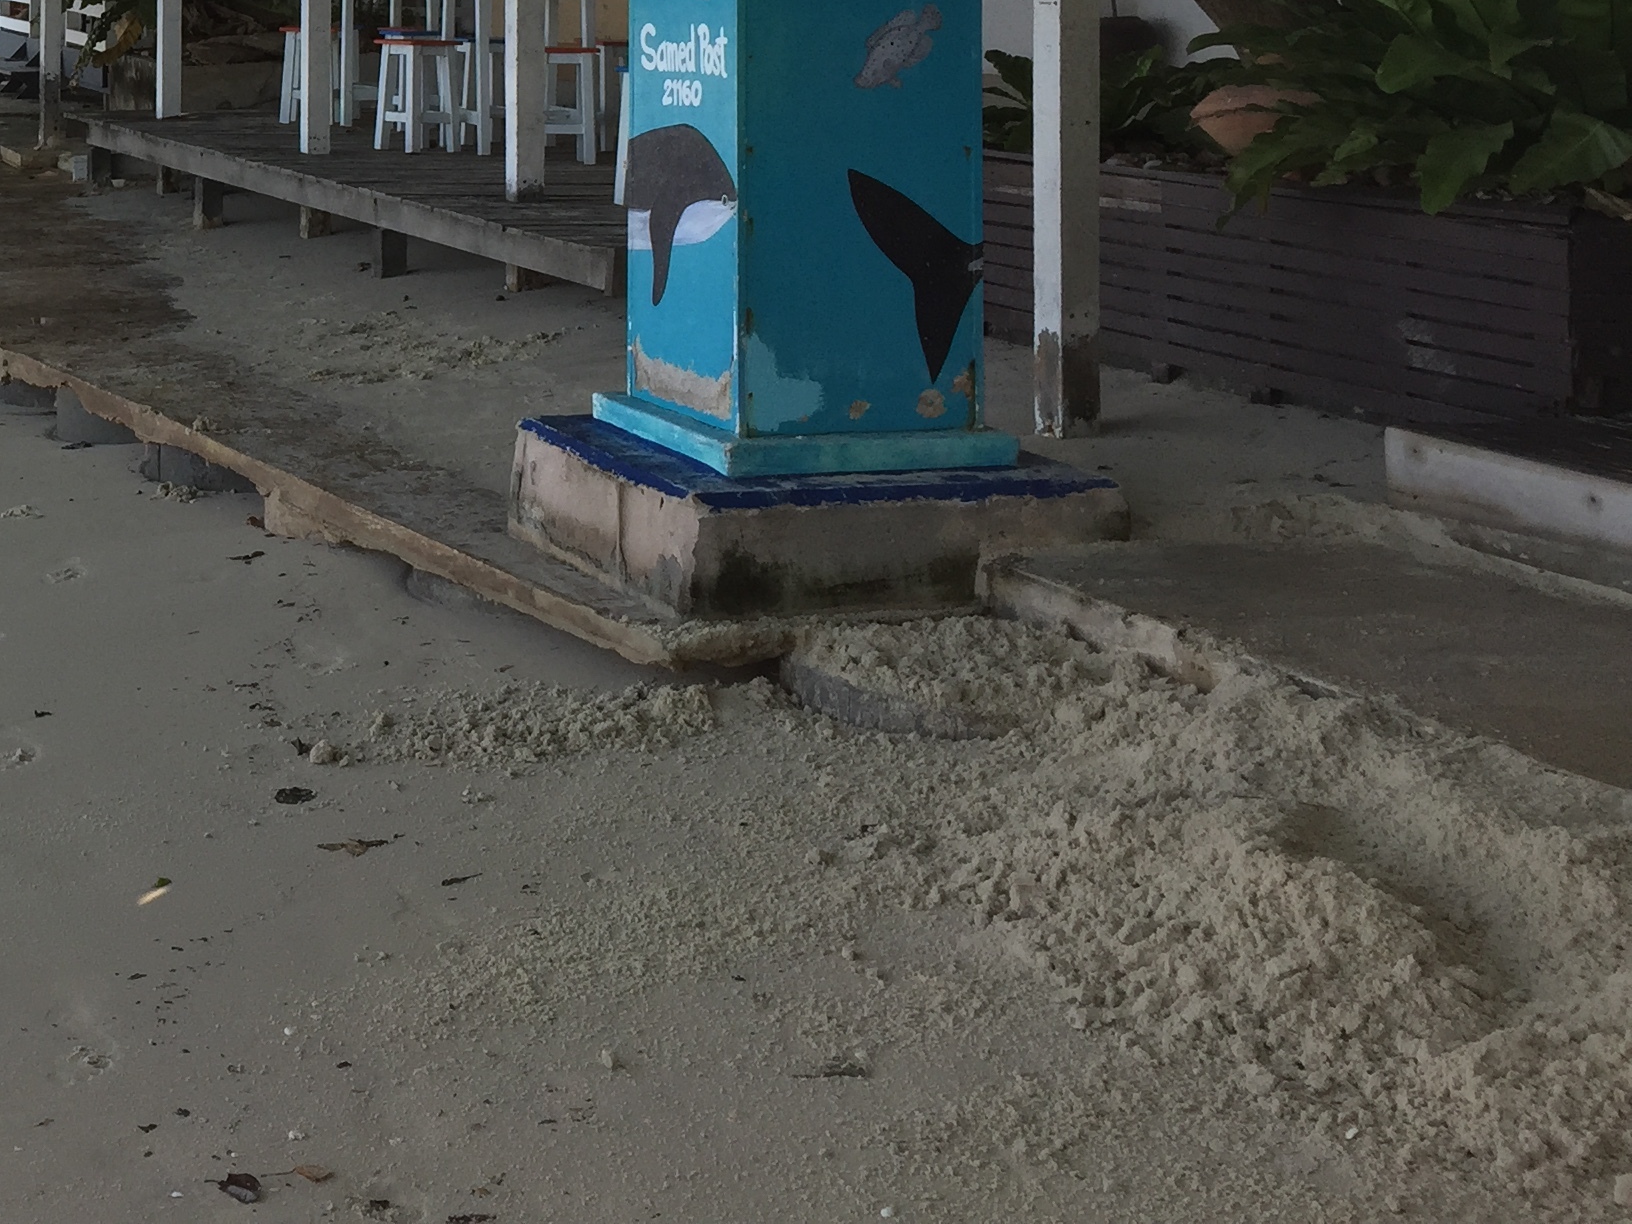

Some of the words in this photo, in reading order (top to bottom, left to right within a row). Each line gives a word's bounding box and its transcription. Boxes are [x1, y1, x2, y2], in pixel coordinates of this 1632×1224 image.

[640, 22, 696, 73] Samed
[697, 22, 729, 79] Post
[662, 78, 703, 107] 21160
